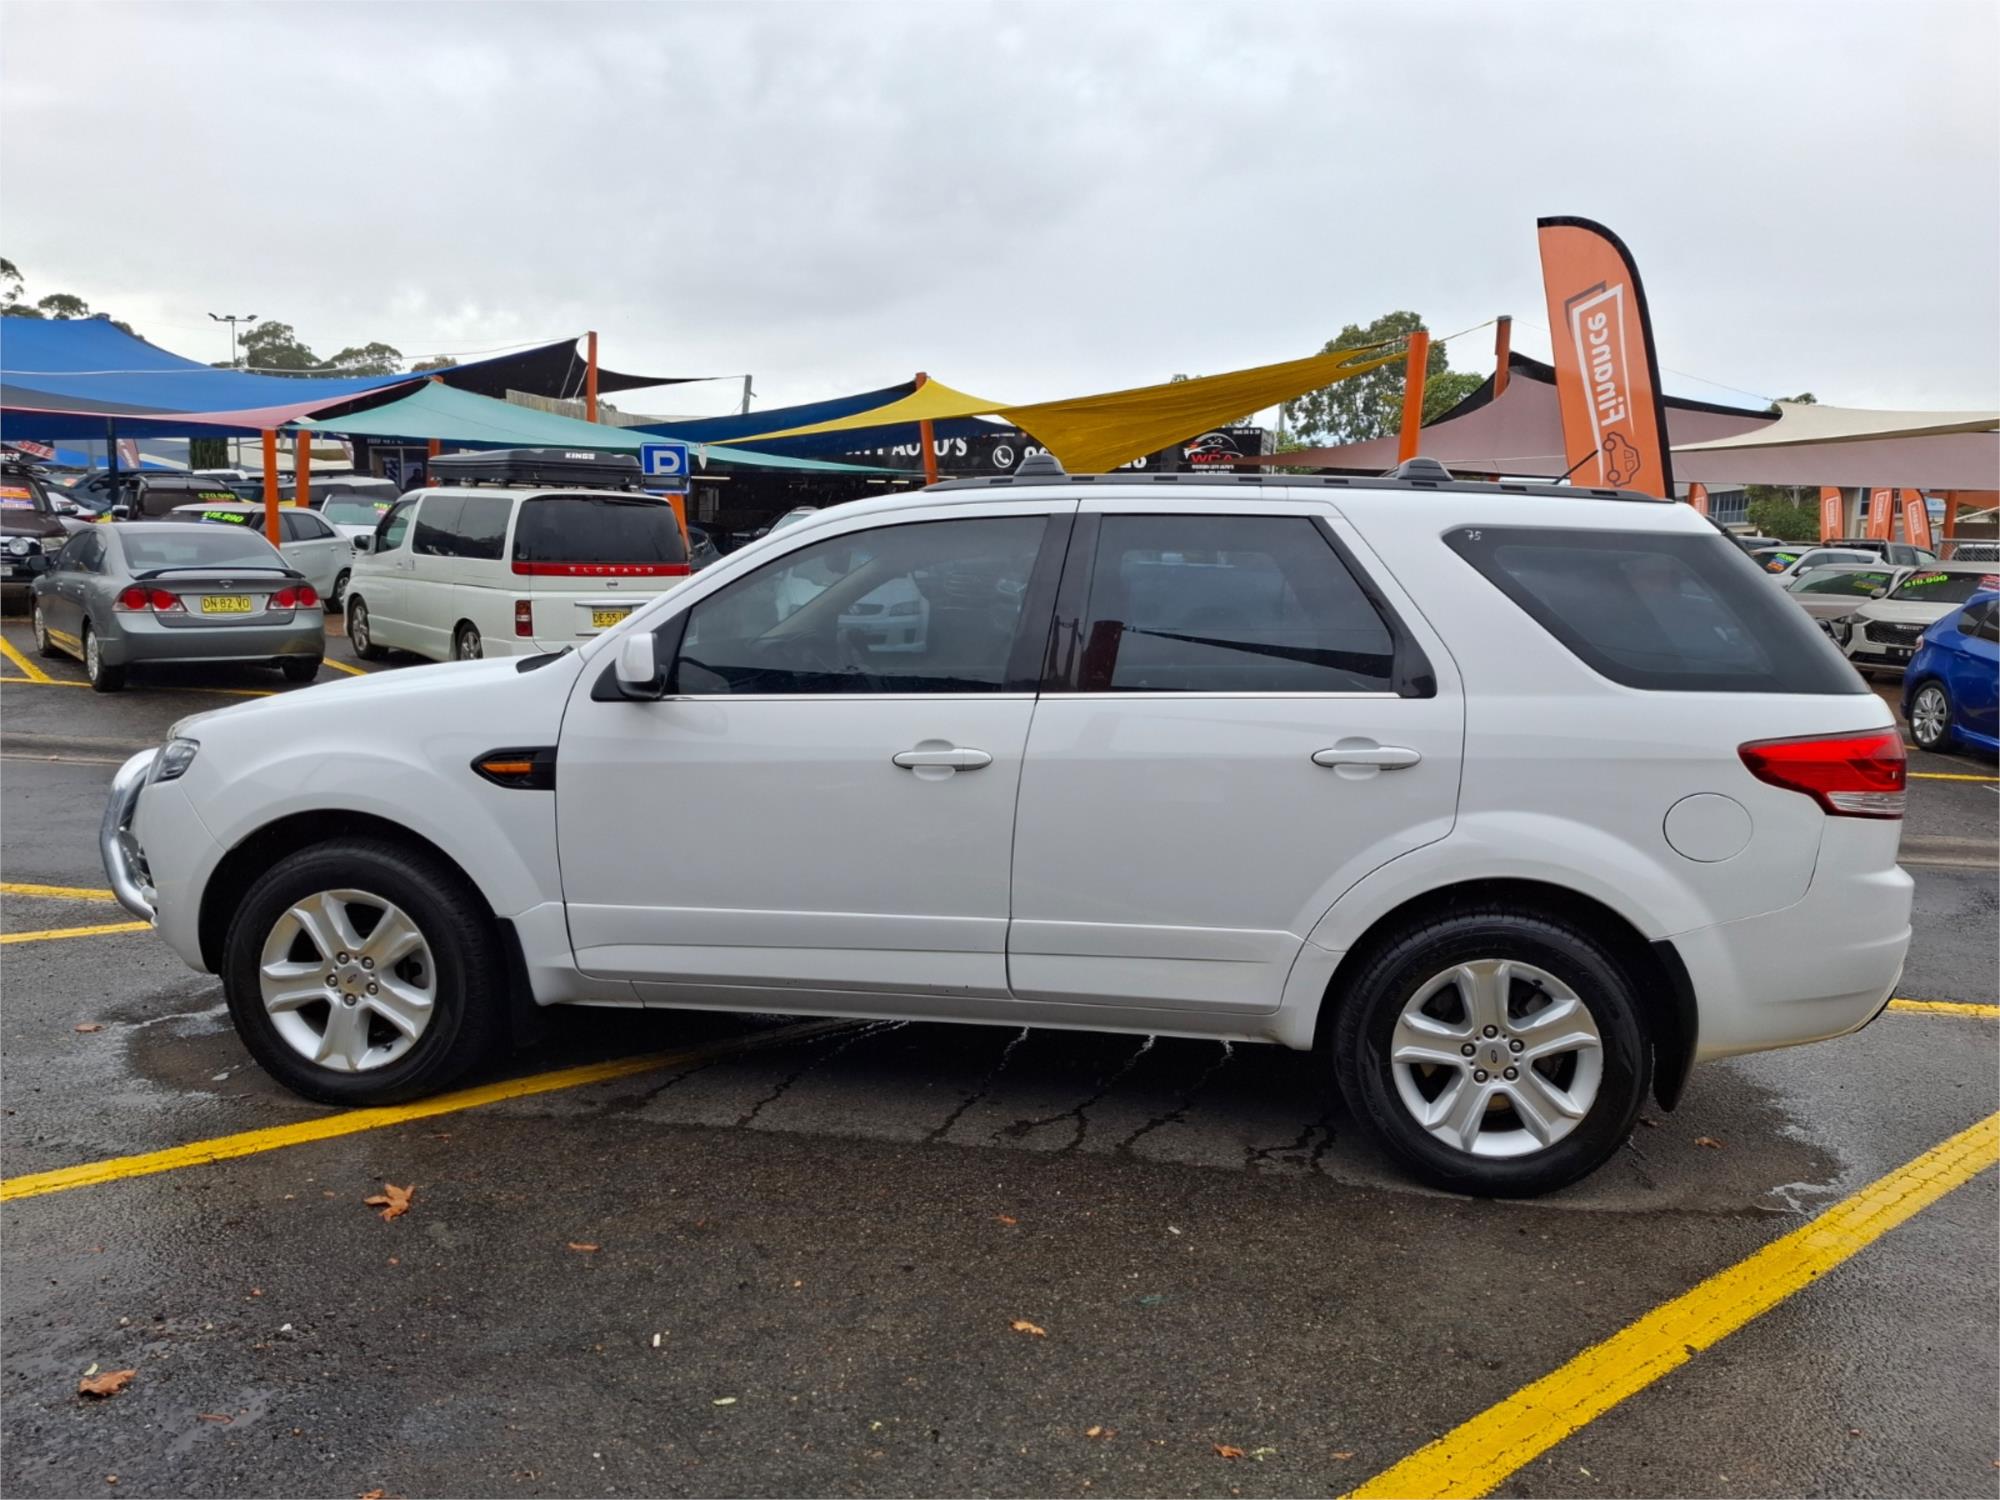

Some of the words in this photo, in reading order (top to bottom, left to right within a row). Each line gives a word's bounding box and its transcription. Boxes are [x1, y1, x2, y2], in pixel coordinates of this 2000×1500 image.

[891, 437, 967, 456] AUO'S
[565, 452, 596, 460] KINGS
[654, 451, 681, 475] P
[569, 566, 654, 574] ELGRAND
